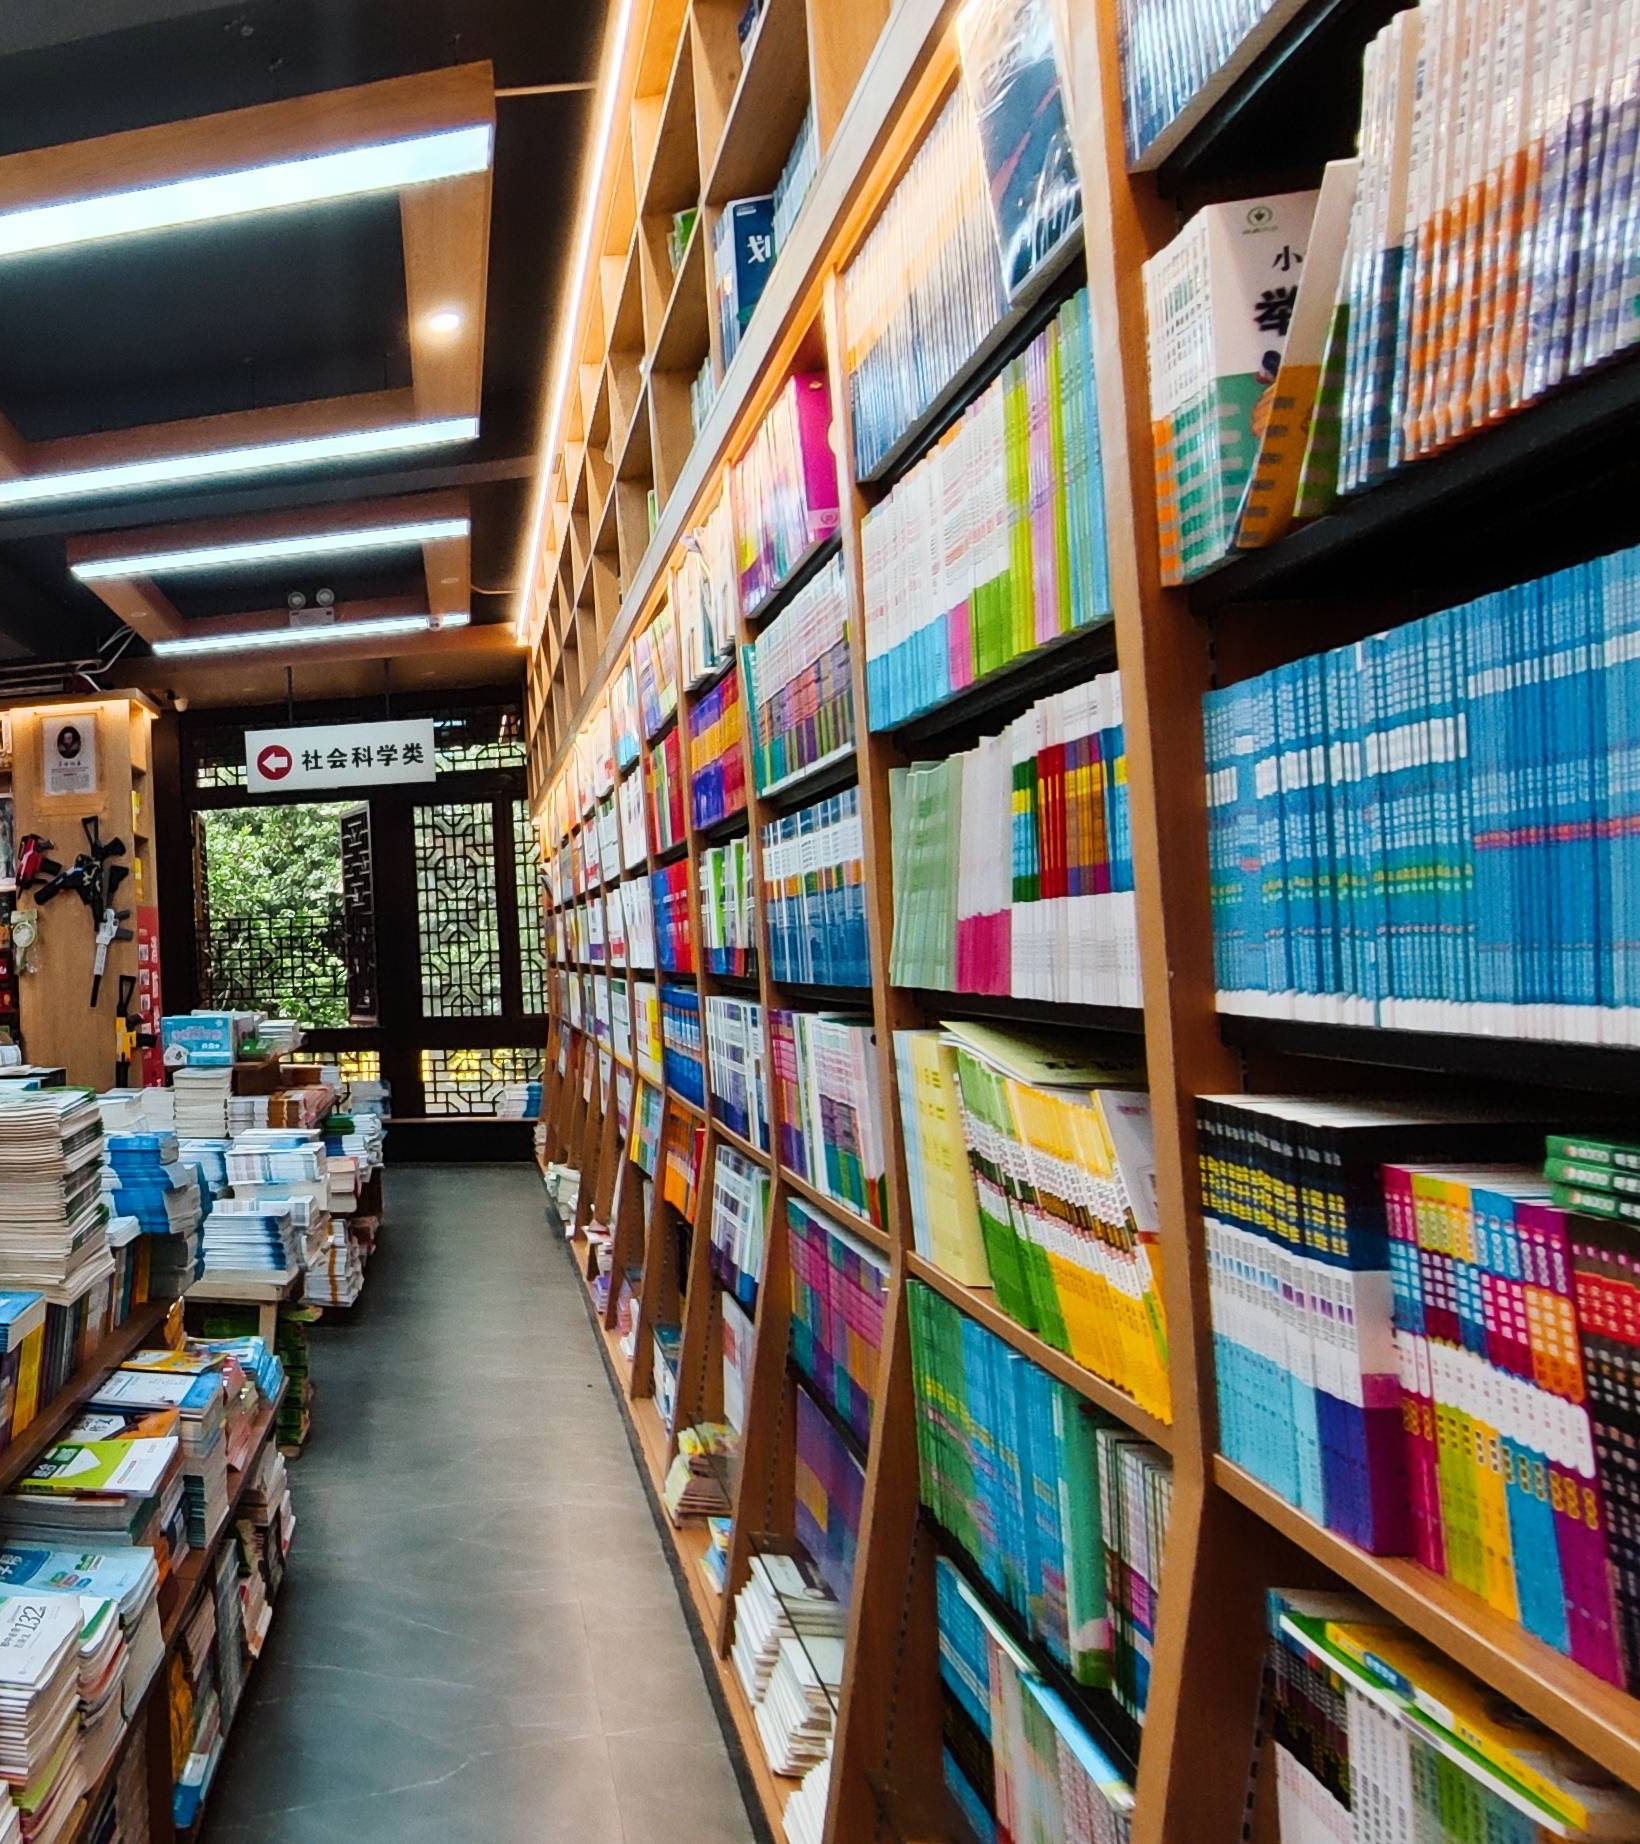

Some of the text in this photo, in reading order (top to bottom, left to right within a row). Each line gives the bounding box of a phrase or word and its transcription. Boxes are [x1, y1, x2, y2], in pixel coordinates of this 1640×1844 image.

[301, 742, 425, 771] 社会科学类
